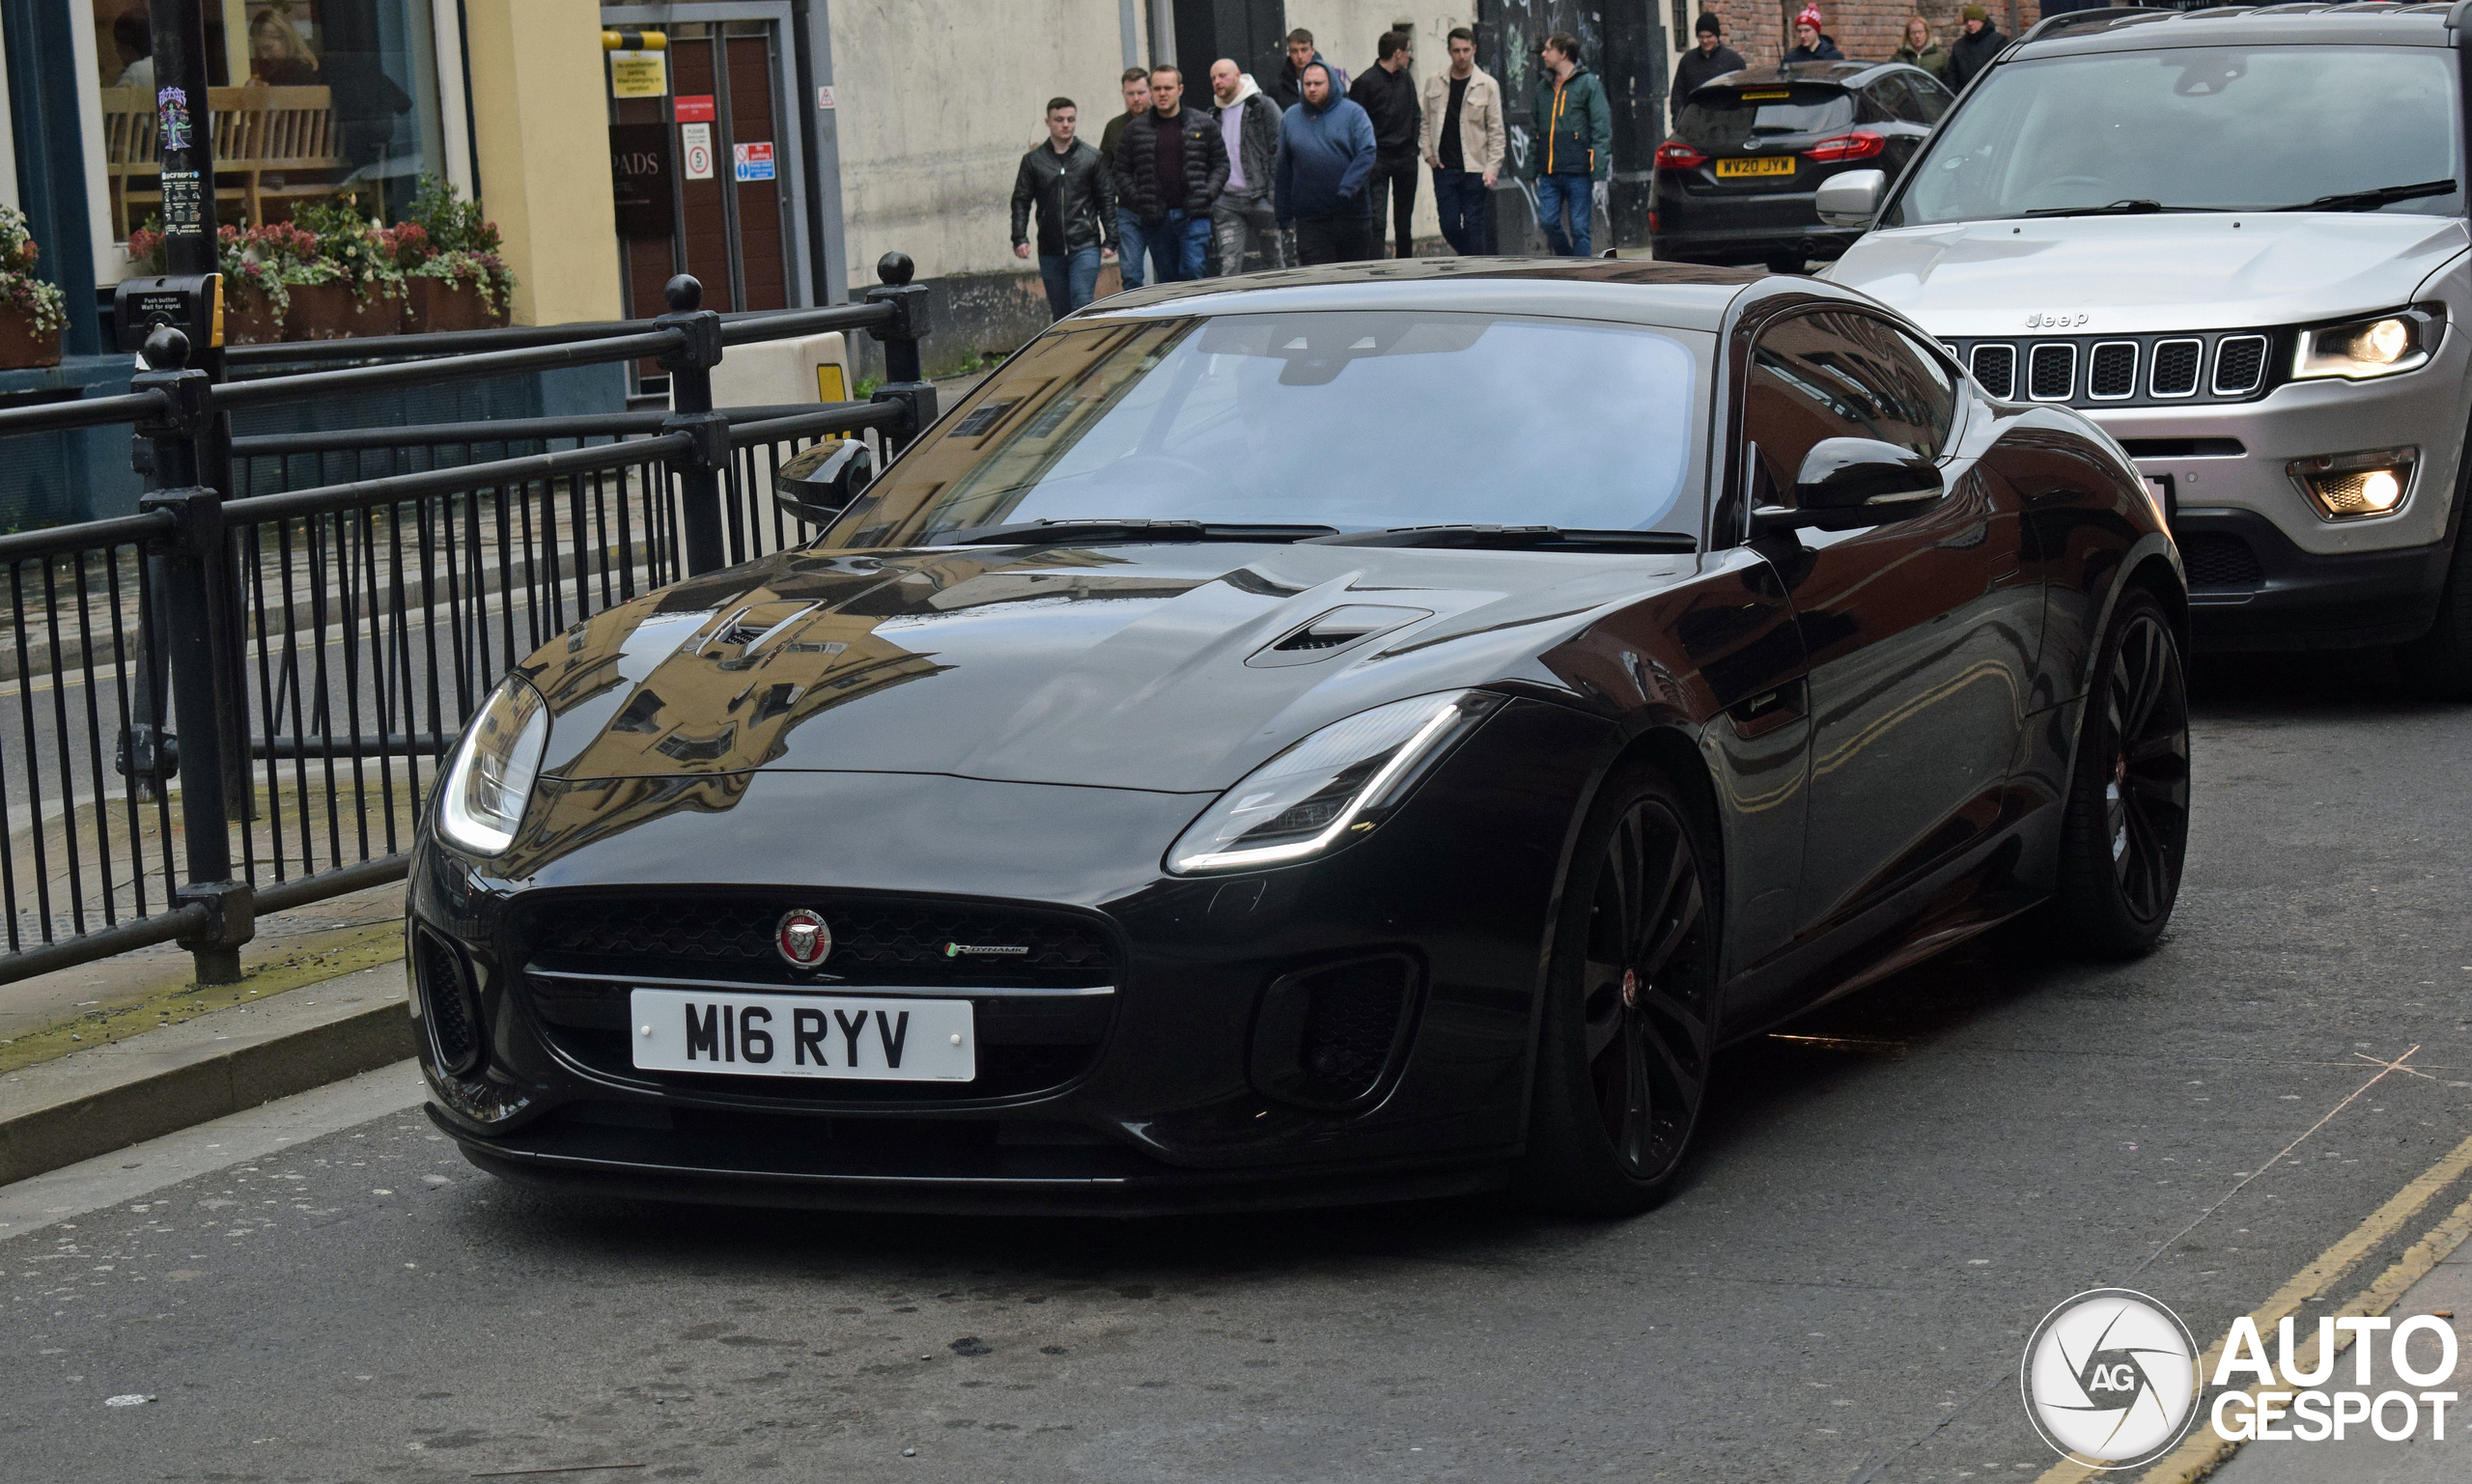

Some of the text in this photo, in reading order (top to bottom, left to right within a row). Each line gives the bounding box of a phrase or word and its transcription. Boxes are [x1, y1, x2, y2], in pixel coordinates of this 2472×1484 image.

[695, 152, 702, 164] 5
[1724, 157, 1789, 174] WV20 JYW
[2025, 313, 2089, 328] Jeep
[793, 1007, 910, 1069] RYV
